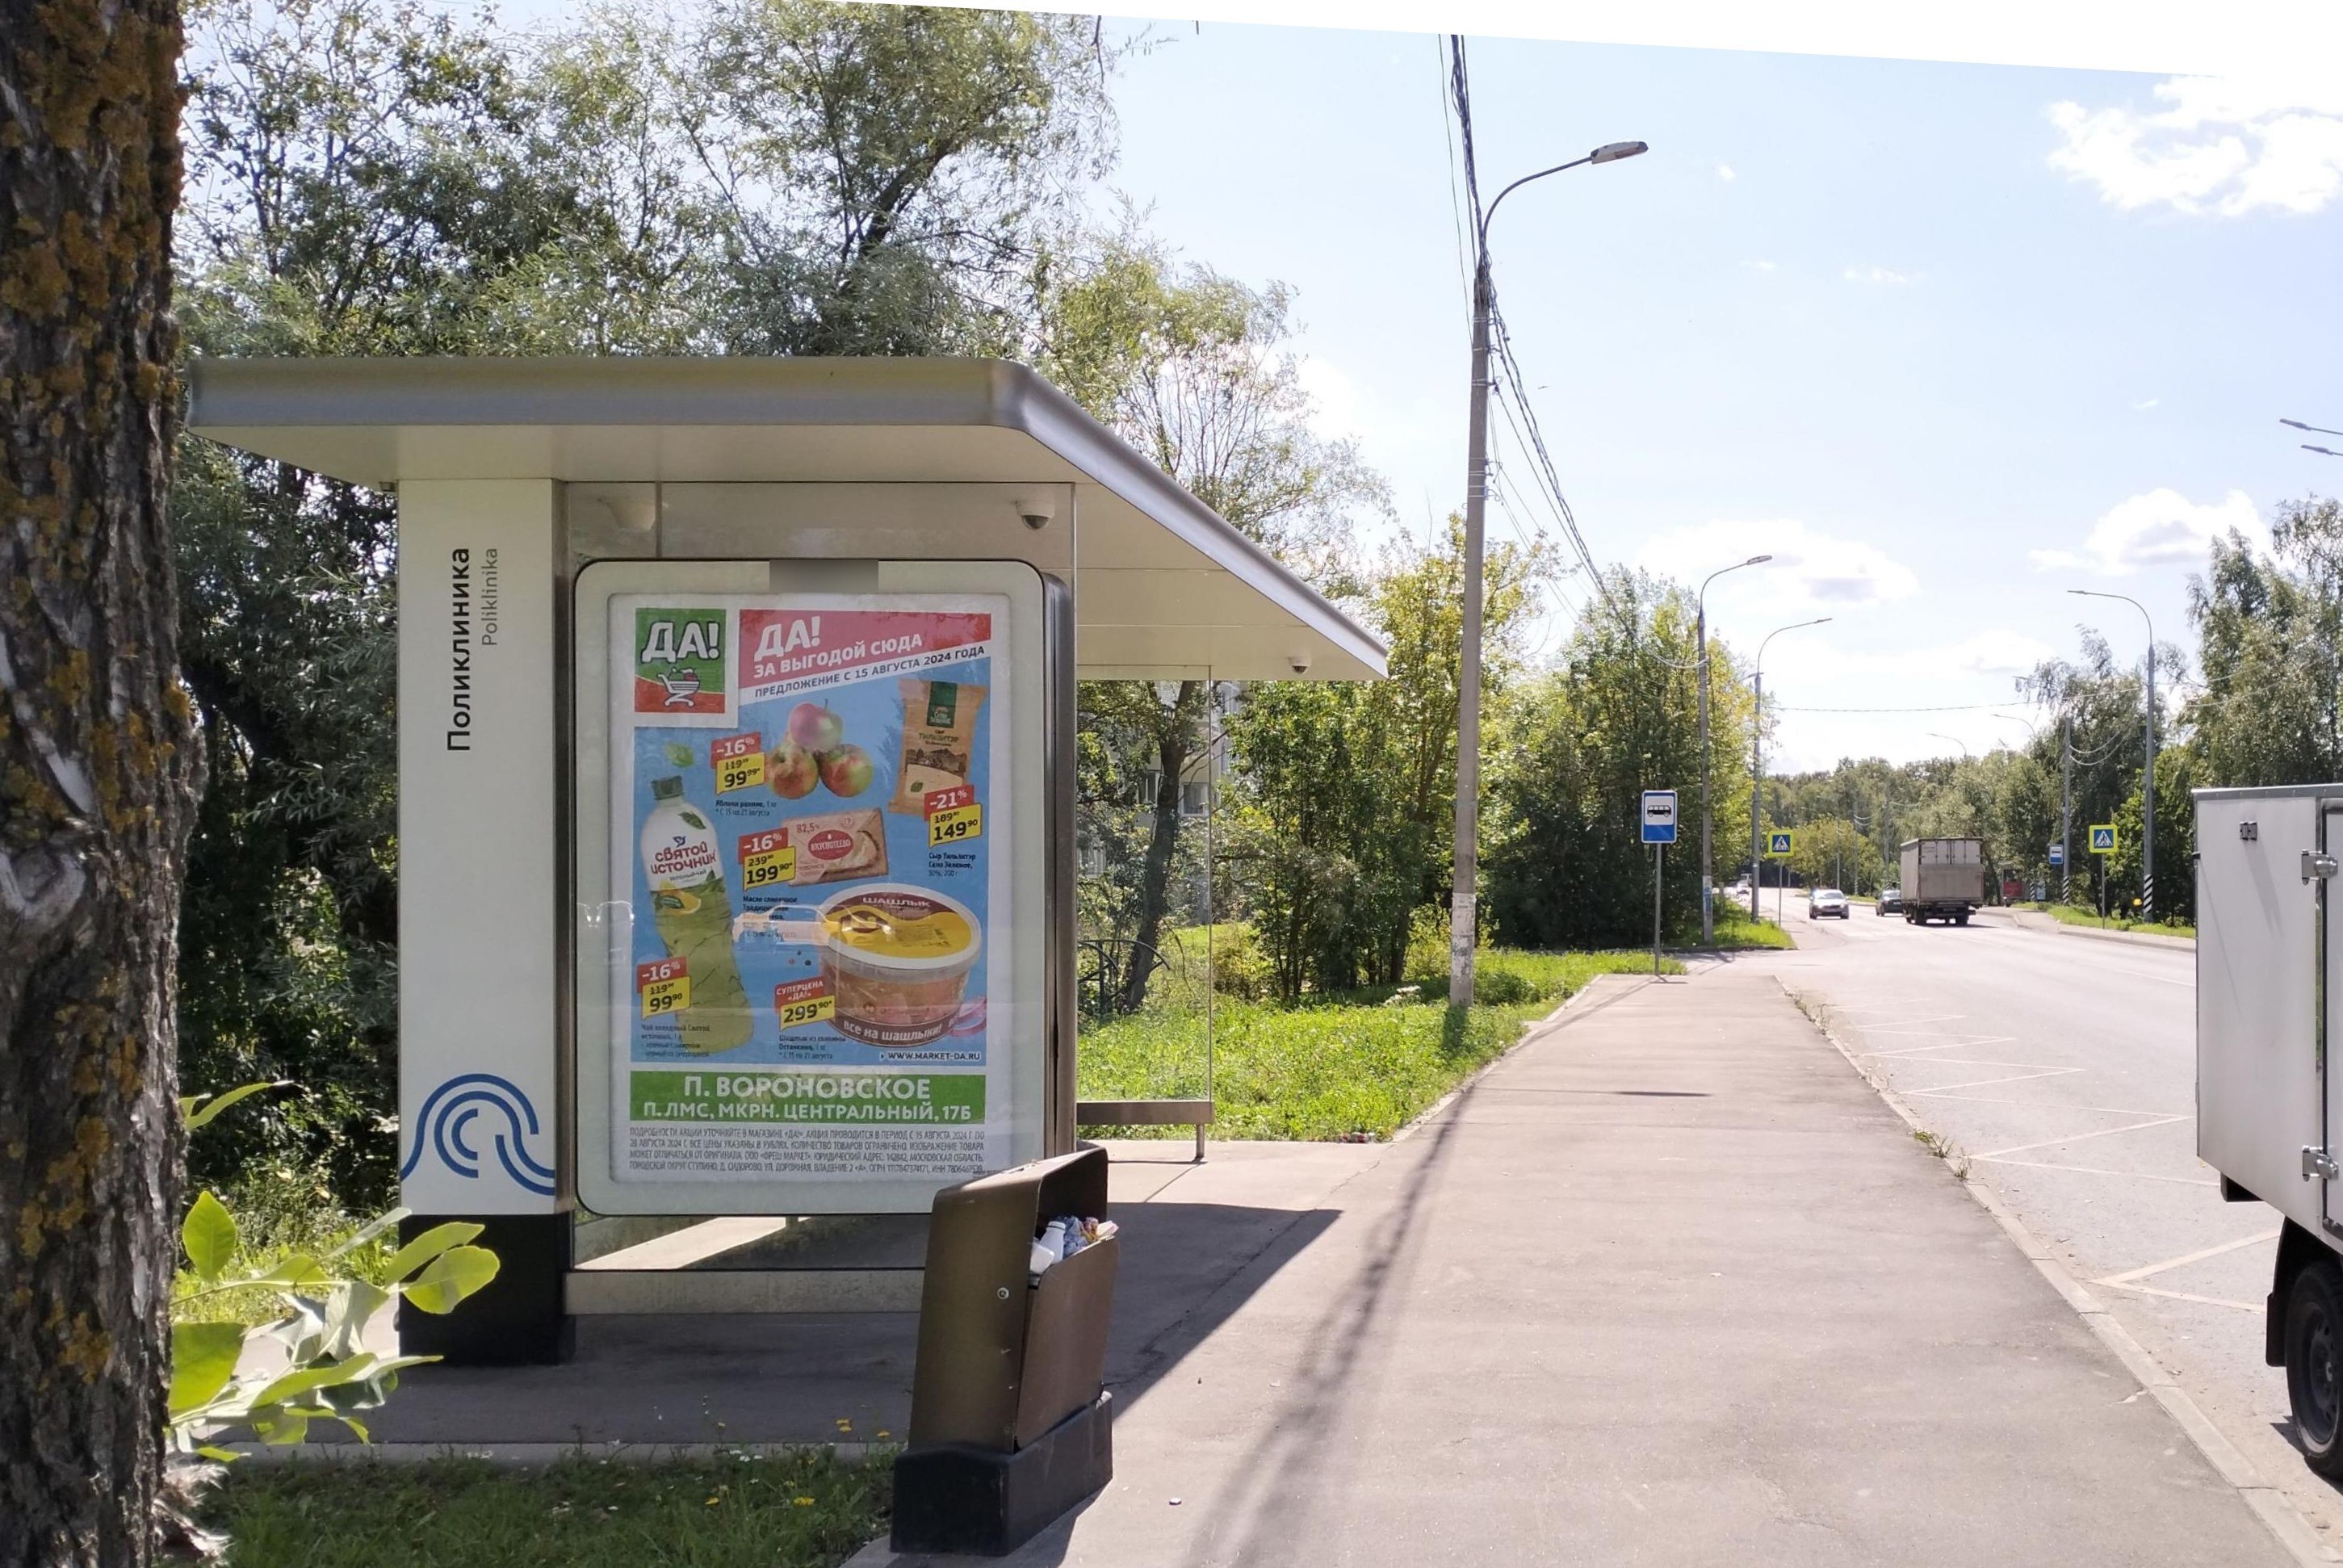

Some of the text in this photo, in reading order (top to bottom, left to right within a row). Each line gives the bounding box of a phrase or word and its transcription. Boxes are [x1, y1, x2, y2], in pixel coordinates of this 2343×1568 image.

[481, 548, 498, 646] Poliklinika
[447, 548, 471, 751] Поликлиника
[641, 621, 720, 664] ДА!
[753, 616, 821, 662] ДА!
[753, 634, 923, 679] ЗА ВЫГОДОЙ СЮДА
[755, 646, 985, 698] ПРЕДЛОЖЕНИЕ С 15 АВГУСТА 2024 ГОДА
[776, 980, 824, 996] СУПЕРЦЕНА
[887, 1052, 980, 1060] WWW.MARKET-DA.RU
[684, 1076, 931, 1100] П. ВОРОНОВСКОЕ
[664, 1102, 715, 1121] ЛМС,
[719, 1103, 779, 1118] МКРН.
[783, 1101, 940, 1123] ЦЕНТРАЛЬНЫЙ,
[943, 1107, 972, 1121] 17Б
